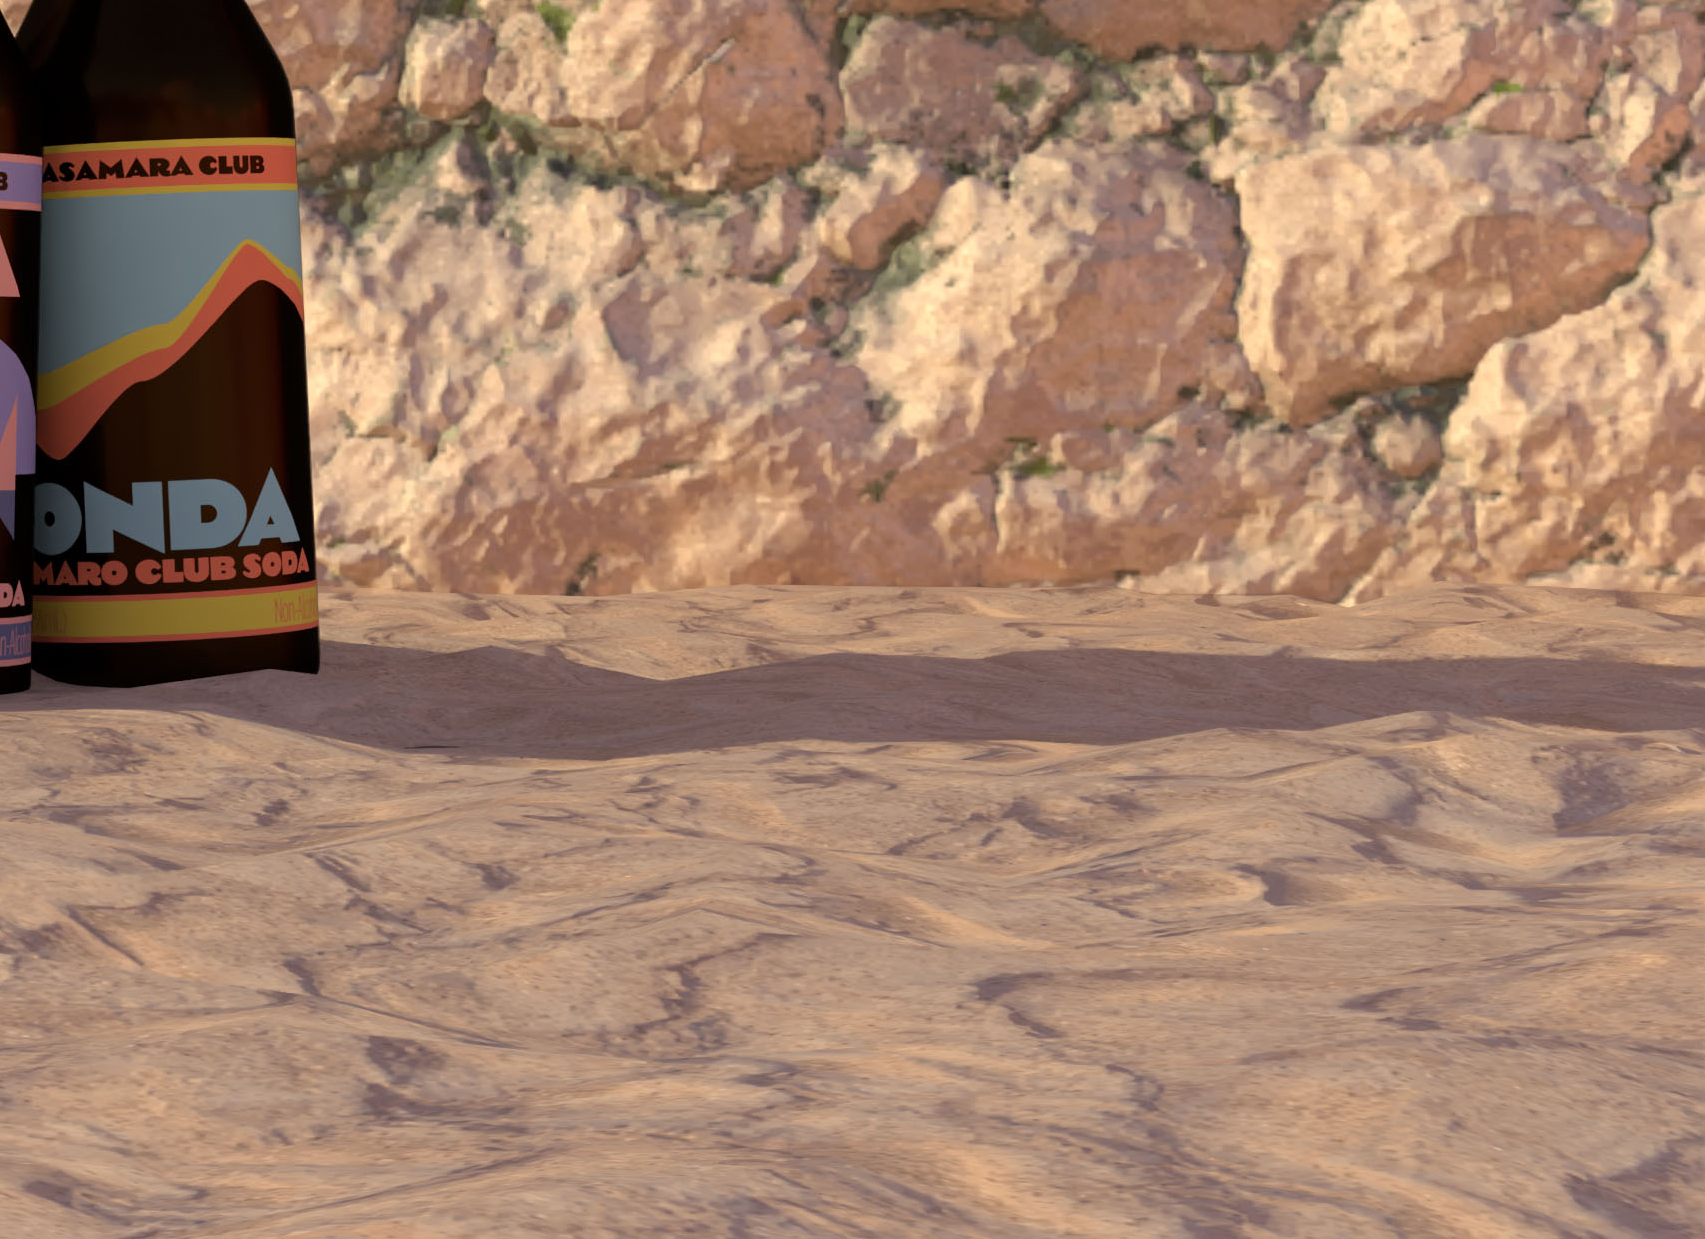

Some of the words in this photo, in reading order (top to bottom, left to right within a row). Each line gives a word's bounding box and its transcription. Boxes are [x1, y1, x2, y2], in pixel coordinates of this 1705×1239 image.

[43, 156, 193, 183] ASAMARA
[198, 155, 266, 175] CLUB
[33, 466, 301, 555] ONDA
[32, 559, 129, 586] MARO
[135, 555, 237, 586] CLUB
[242, 546, 310, 579] SODA
